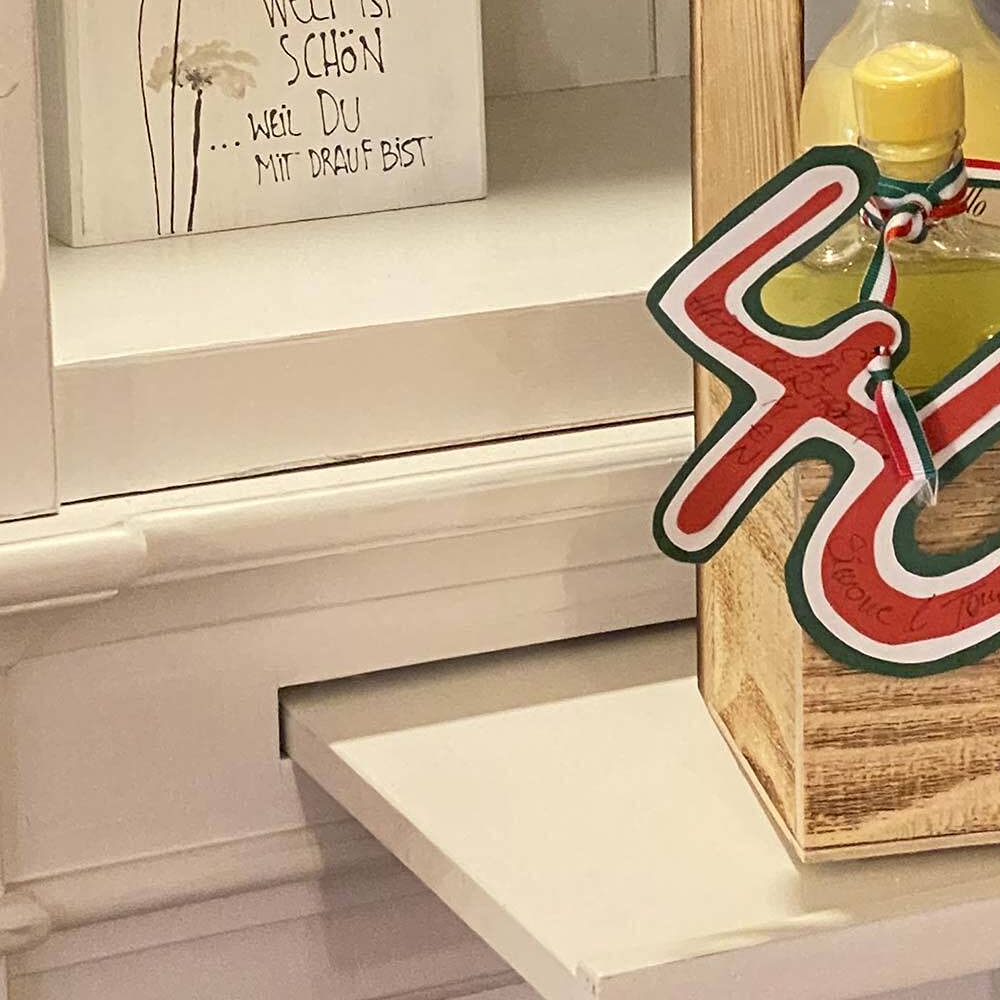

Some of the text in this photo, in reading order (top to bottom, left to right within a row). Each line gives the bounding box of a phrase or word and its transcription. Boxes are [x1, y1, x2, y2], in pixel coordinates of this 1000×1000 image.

[279, 26, 385, 86] SCHÖN
[316, 88, 360, 136] DU
[308, 139, 371, 179] DRAUF
